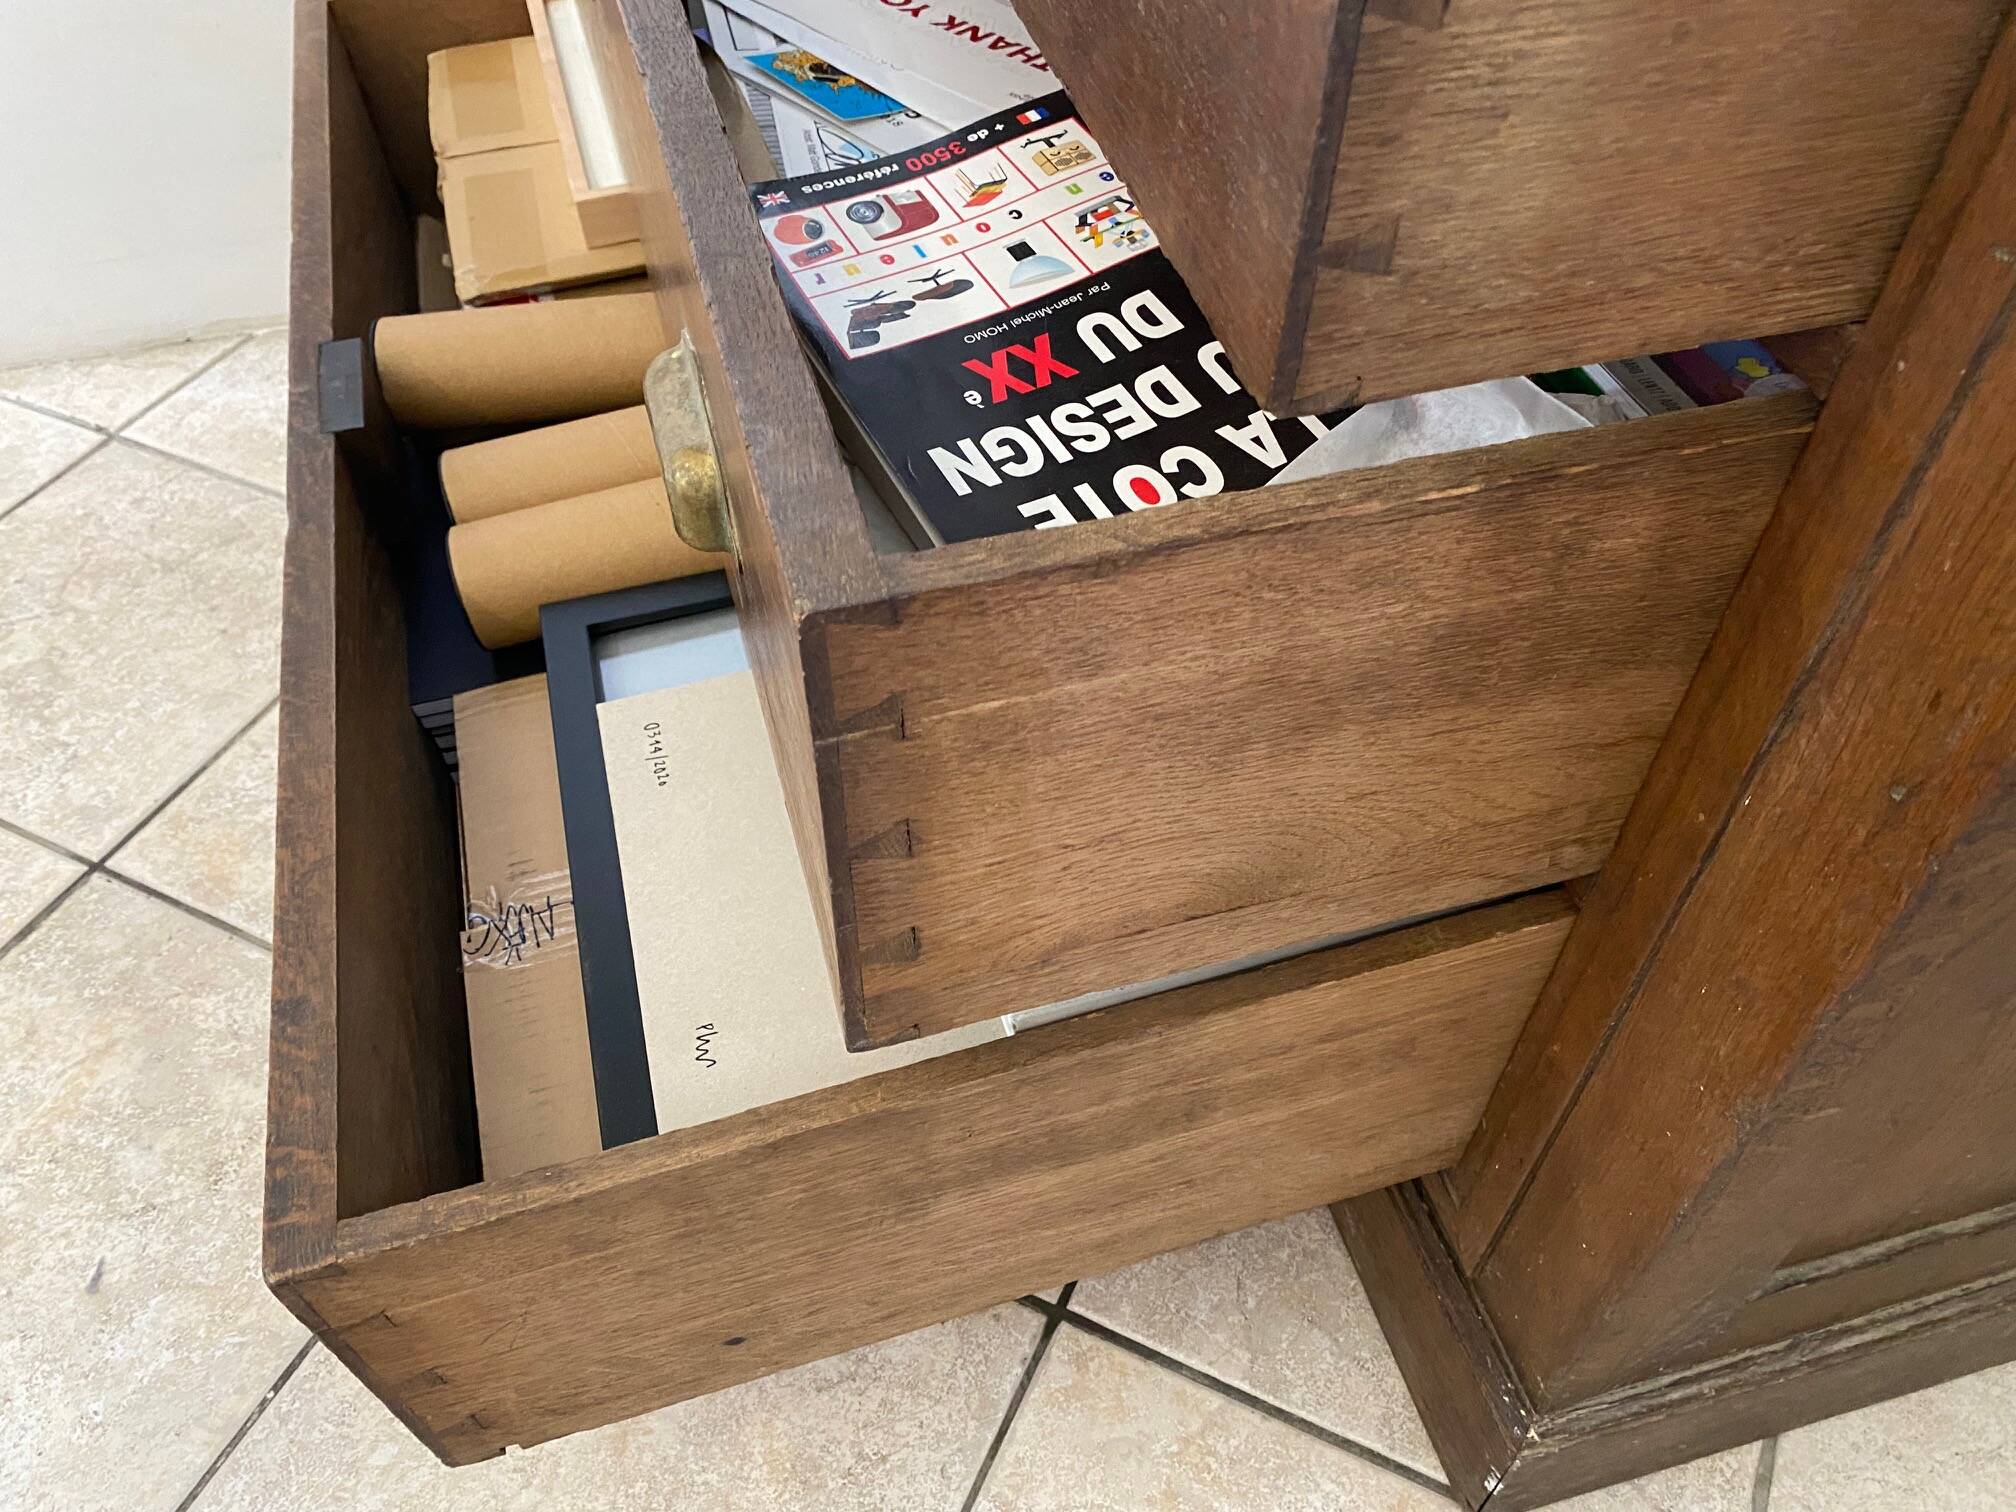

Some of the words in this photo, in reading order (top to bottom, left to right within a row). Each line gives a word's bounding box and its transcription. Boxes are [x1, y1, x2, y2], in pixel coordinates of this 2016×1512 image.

[930, 15, 1049, 72] THANK
[966, 128, 989, 143] de
[905, 141, 967, 172] 3500
[801, 161, 900, 194] références
[1087, 281, 1111, 297] Par
[1010, 291, 1083, 329] Jean-Michel
[963, 323, 1009, 344] HOMO
[1076, 290, 1185, 364] DU
[927, 364, 1202, 497] DESIGN
